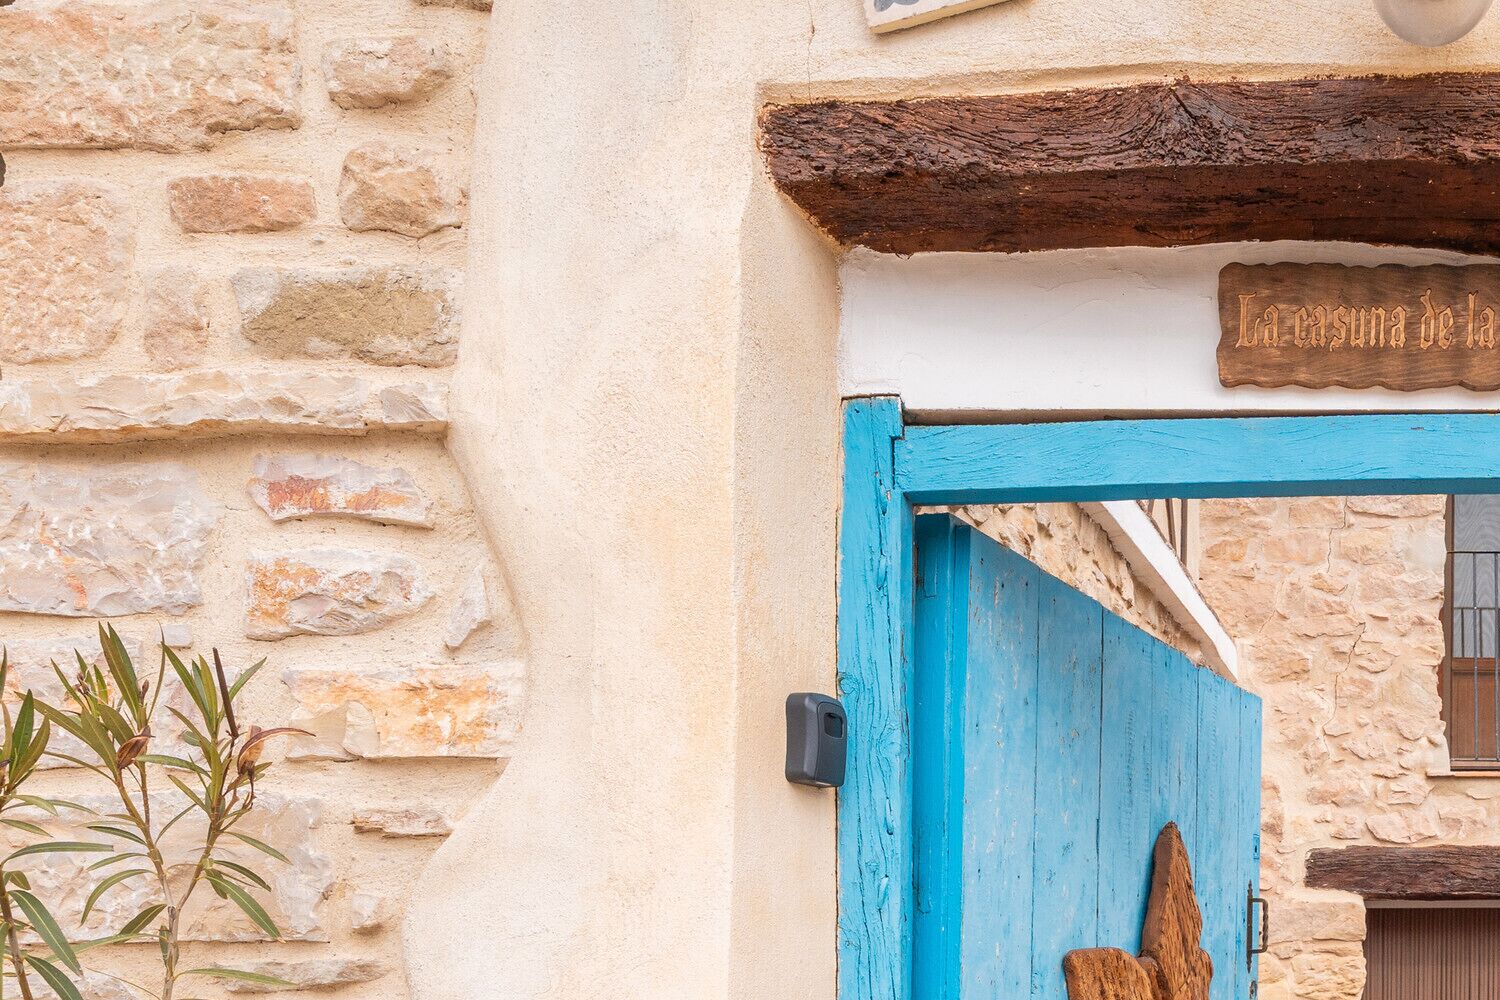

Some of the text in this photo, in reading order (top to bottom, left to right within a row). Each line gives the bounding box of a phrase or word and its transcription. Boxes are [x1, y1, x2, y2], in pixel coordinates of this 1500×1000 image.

[1235, 292, 1281, 349] La
[1294, 304, 1407, 352] casuna
[1419, 288, 1454, 350] de
[1466, 290, 1496, 350] la
